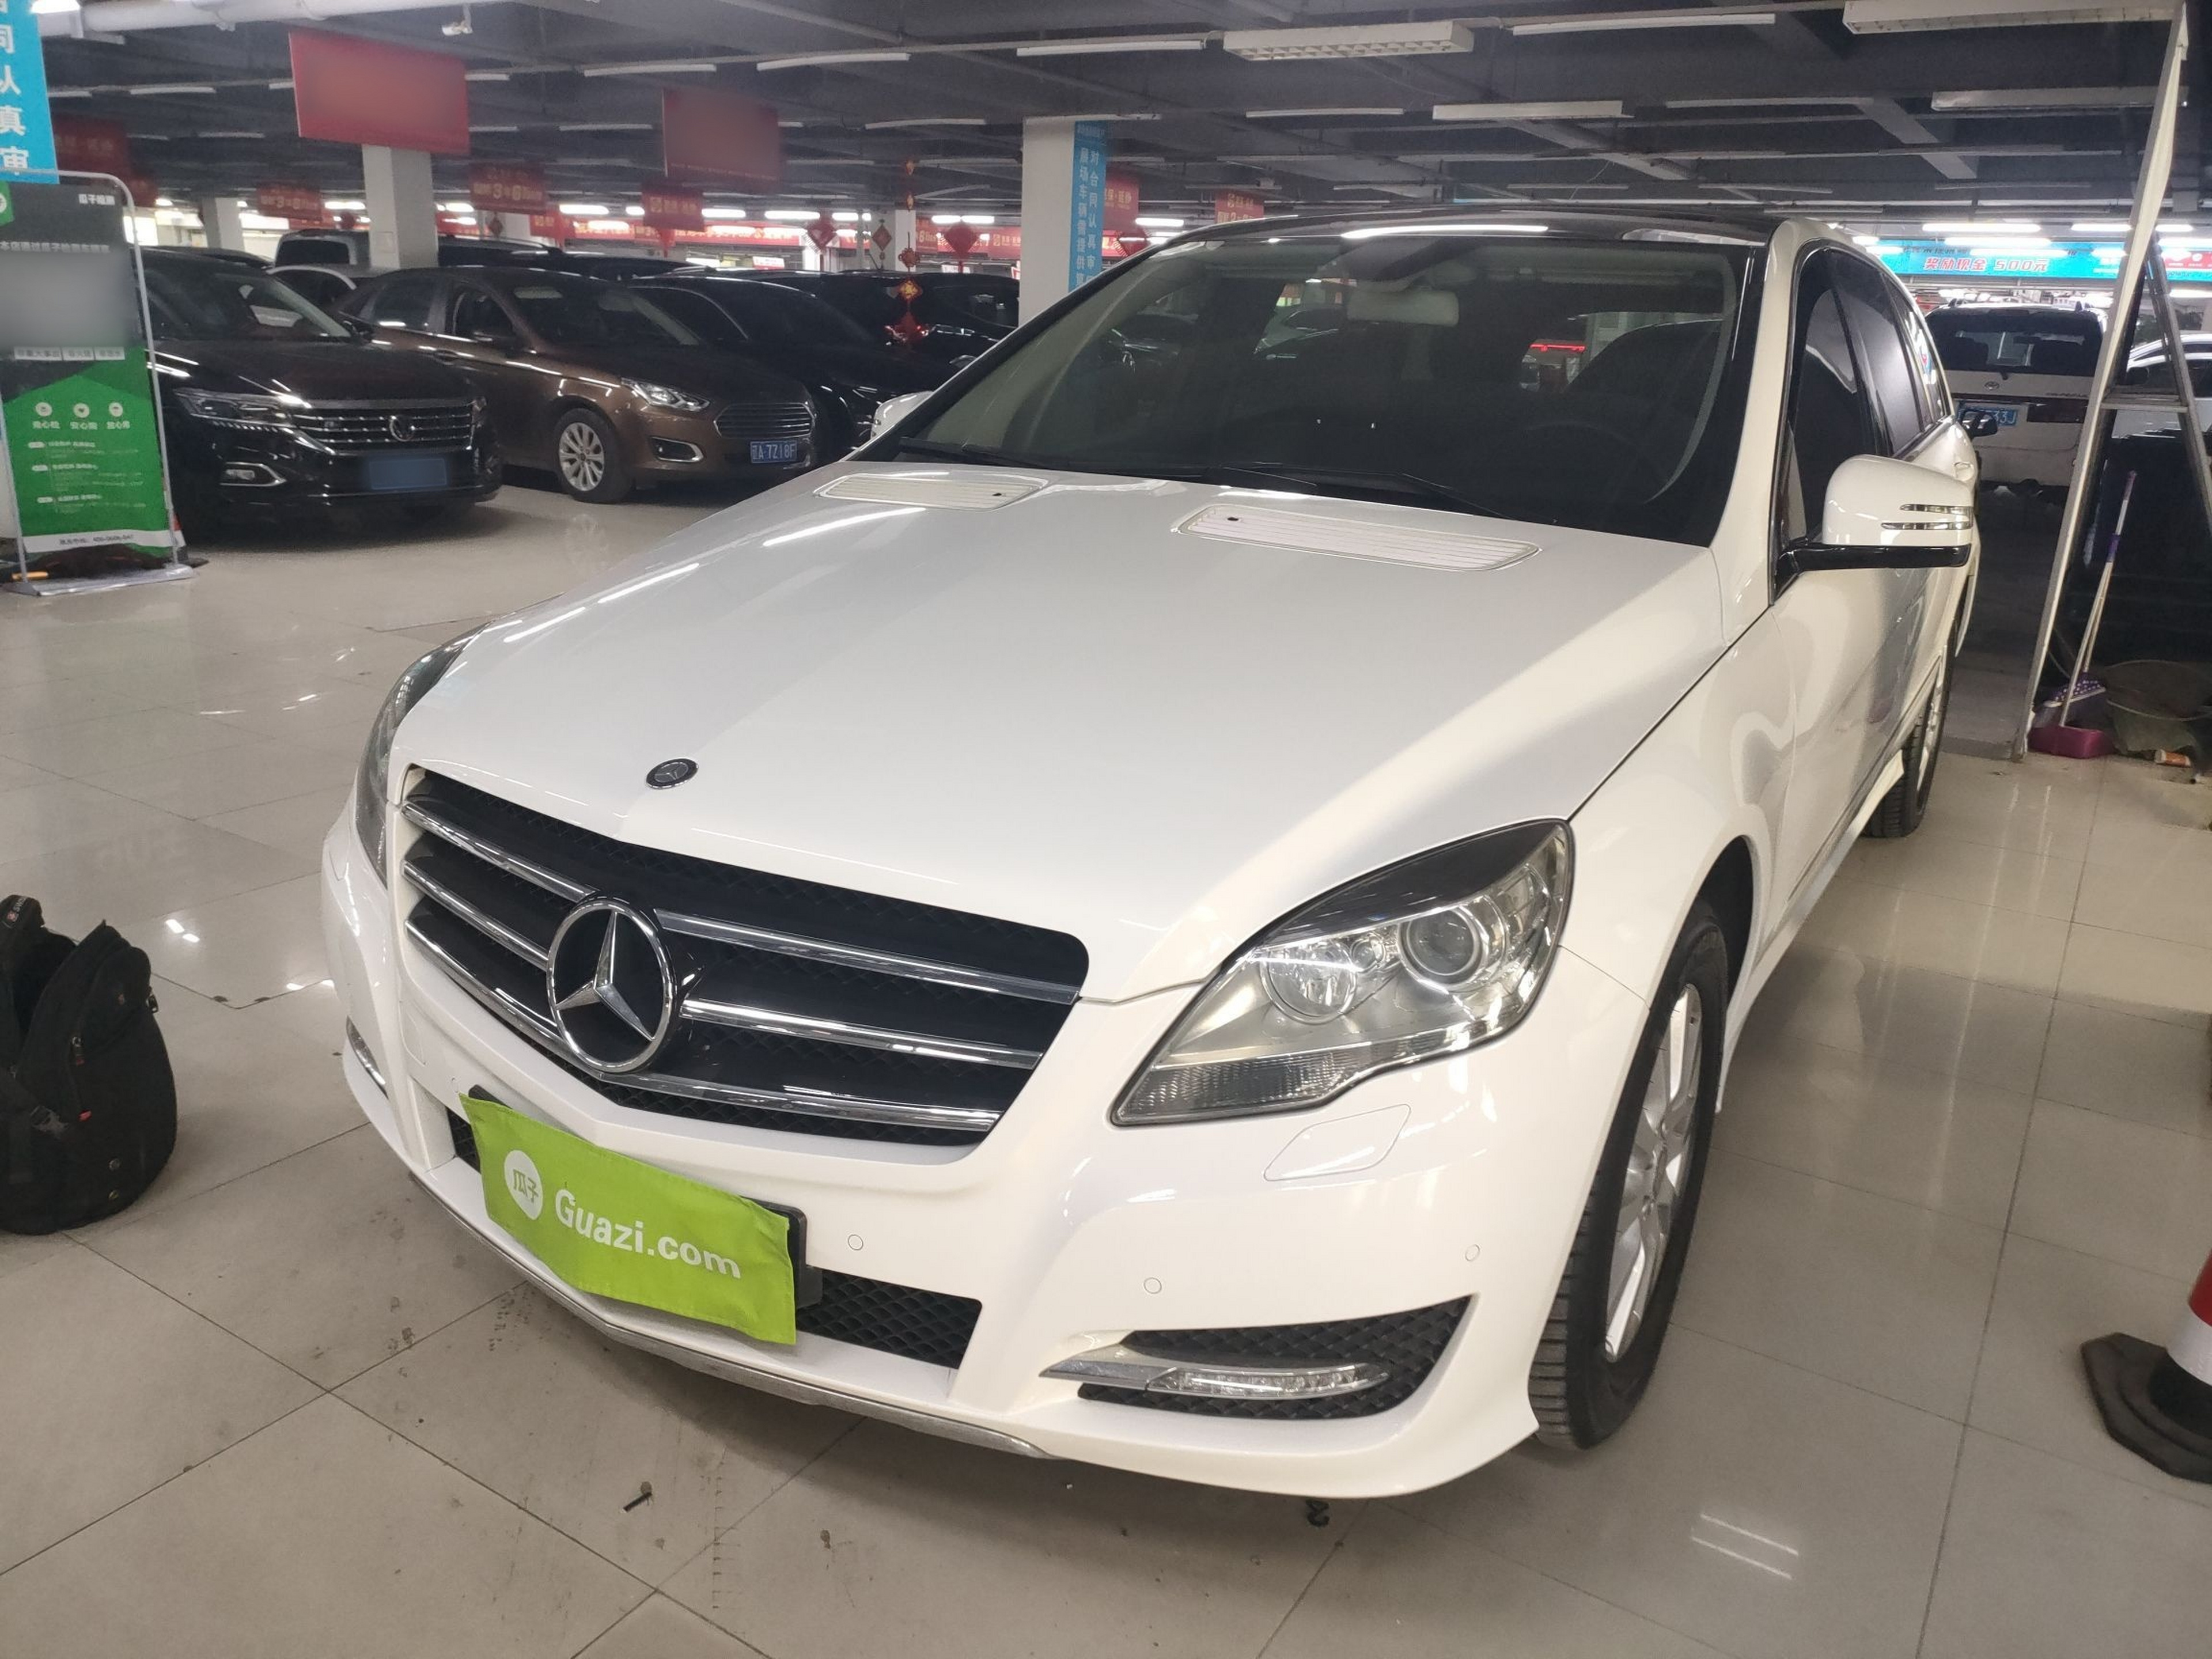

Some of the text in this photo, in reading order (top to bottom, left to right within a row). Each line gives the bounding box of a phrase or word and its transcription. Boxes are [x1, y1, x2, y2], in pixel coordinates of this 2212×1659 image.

[1925, 257, 2049, 271] 奖励现金 500元
[513, 1169, 539, 1203] 瓜子
[555, 1188, 742, 1280] Guazi.com
